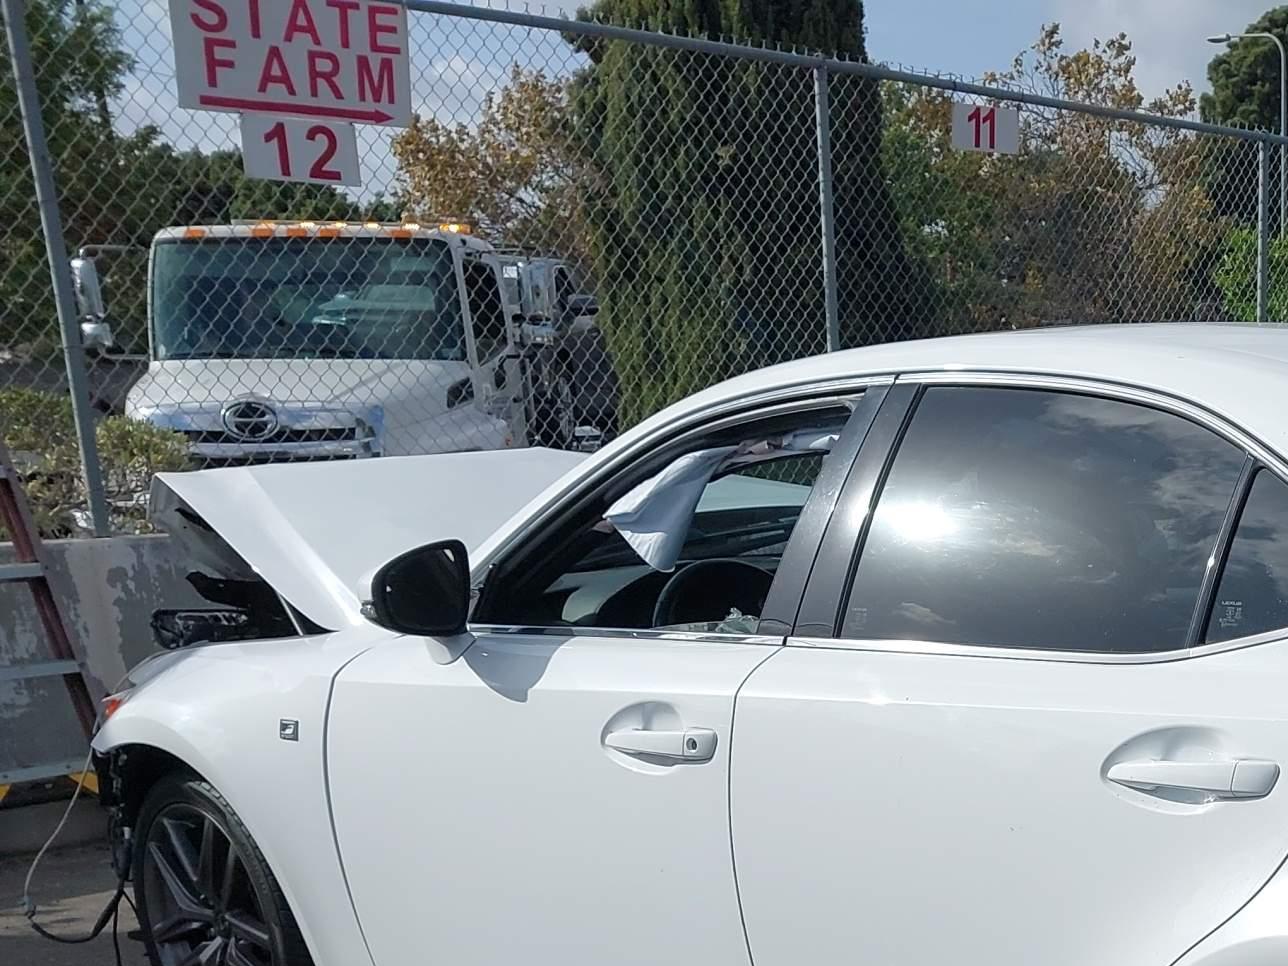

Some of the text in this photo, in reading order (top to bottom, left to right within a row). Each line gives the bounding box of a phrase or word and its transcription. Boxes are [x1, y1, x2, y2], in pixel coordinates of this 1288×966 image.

[190, 0, 401, 54] STATE
[203, 37, 395, 104] FARM
[263, 121, 342, 181] 12
[967, 106, 996, 149] 11
